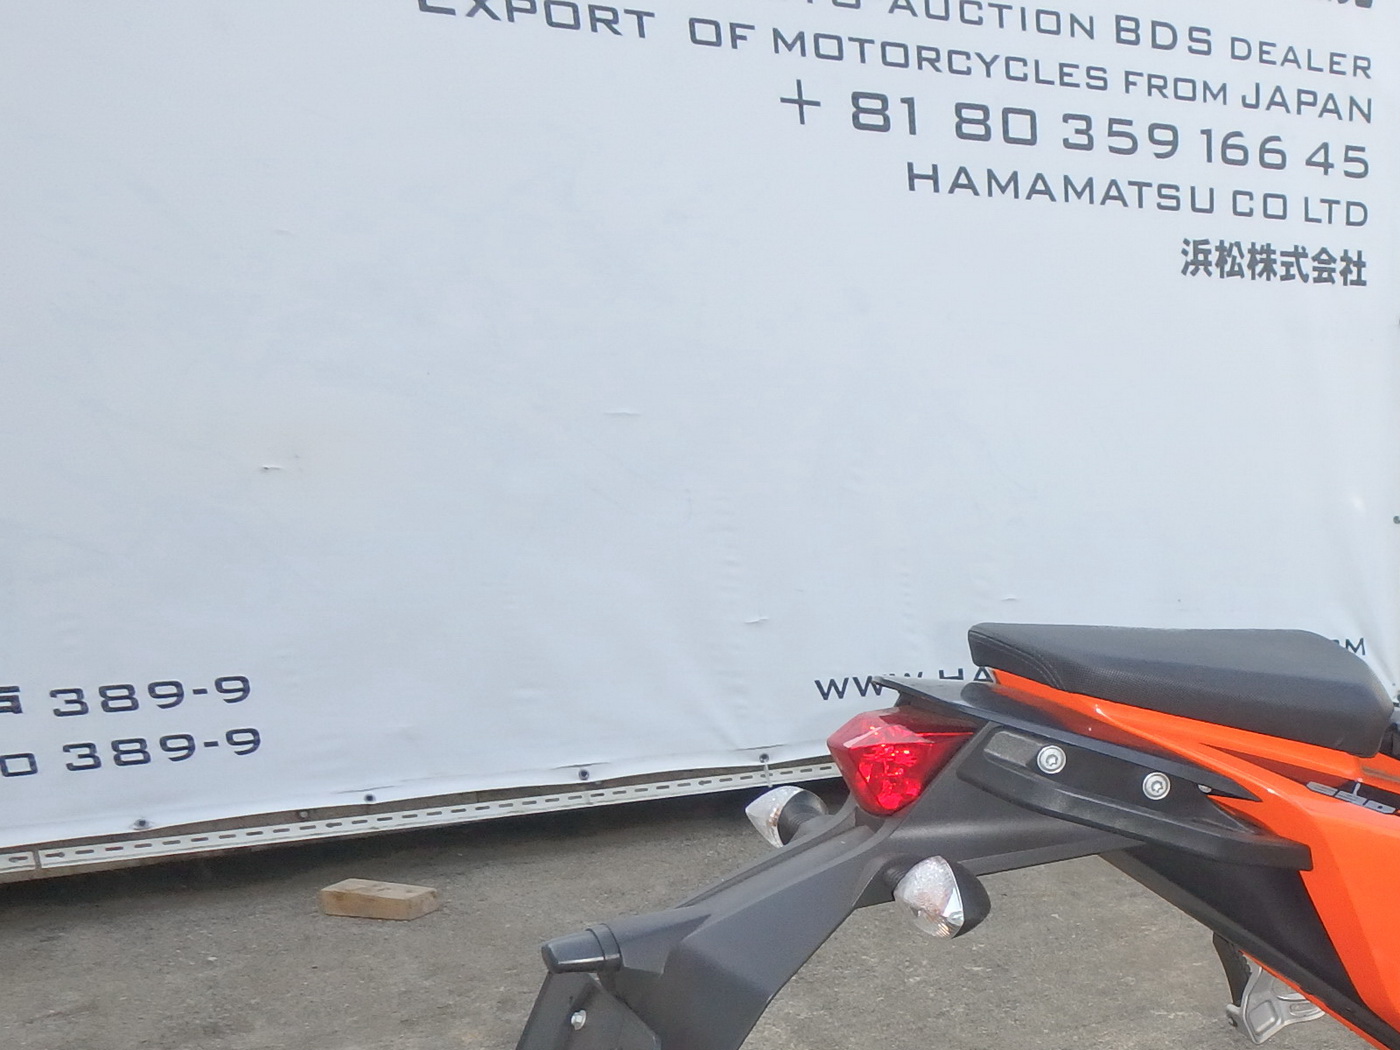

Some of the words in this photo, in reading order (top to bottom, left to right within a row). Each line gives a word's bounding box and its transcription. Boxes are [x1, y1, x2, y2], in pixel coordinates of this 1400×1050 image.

[688, 18, 756, 50] OF
[773, 28, 1108, 92] MOTORCYCLES
[1124, 70, 1227, 106] FROM
[1241, 82, 1373, 124] JAPAN
[889, 0, 1095, 40] AUCTION
[1115, 15, 1212, 56] BDS
[1230, 37, 1372, 79] DEALER
[851, 91, 917, 136] 81
[955, 102, 1038, 147] 80
[1062, 113, 1179, 160] 359
[1200, 129, 1287, 171] 166
[1305, 142, 1369, 179] 45
[907, 162, 1215, 214] HAMAMATSU
[1232, 190, 1288, 221] CO
[1304, 197, 1368, 227] LTD
[1181, 237, 1369, 288] 浜松株式会社
[49, 675, 251, 718] 389-9
[62, 727, 261, 772] 389-9
